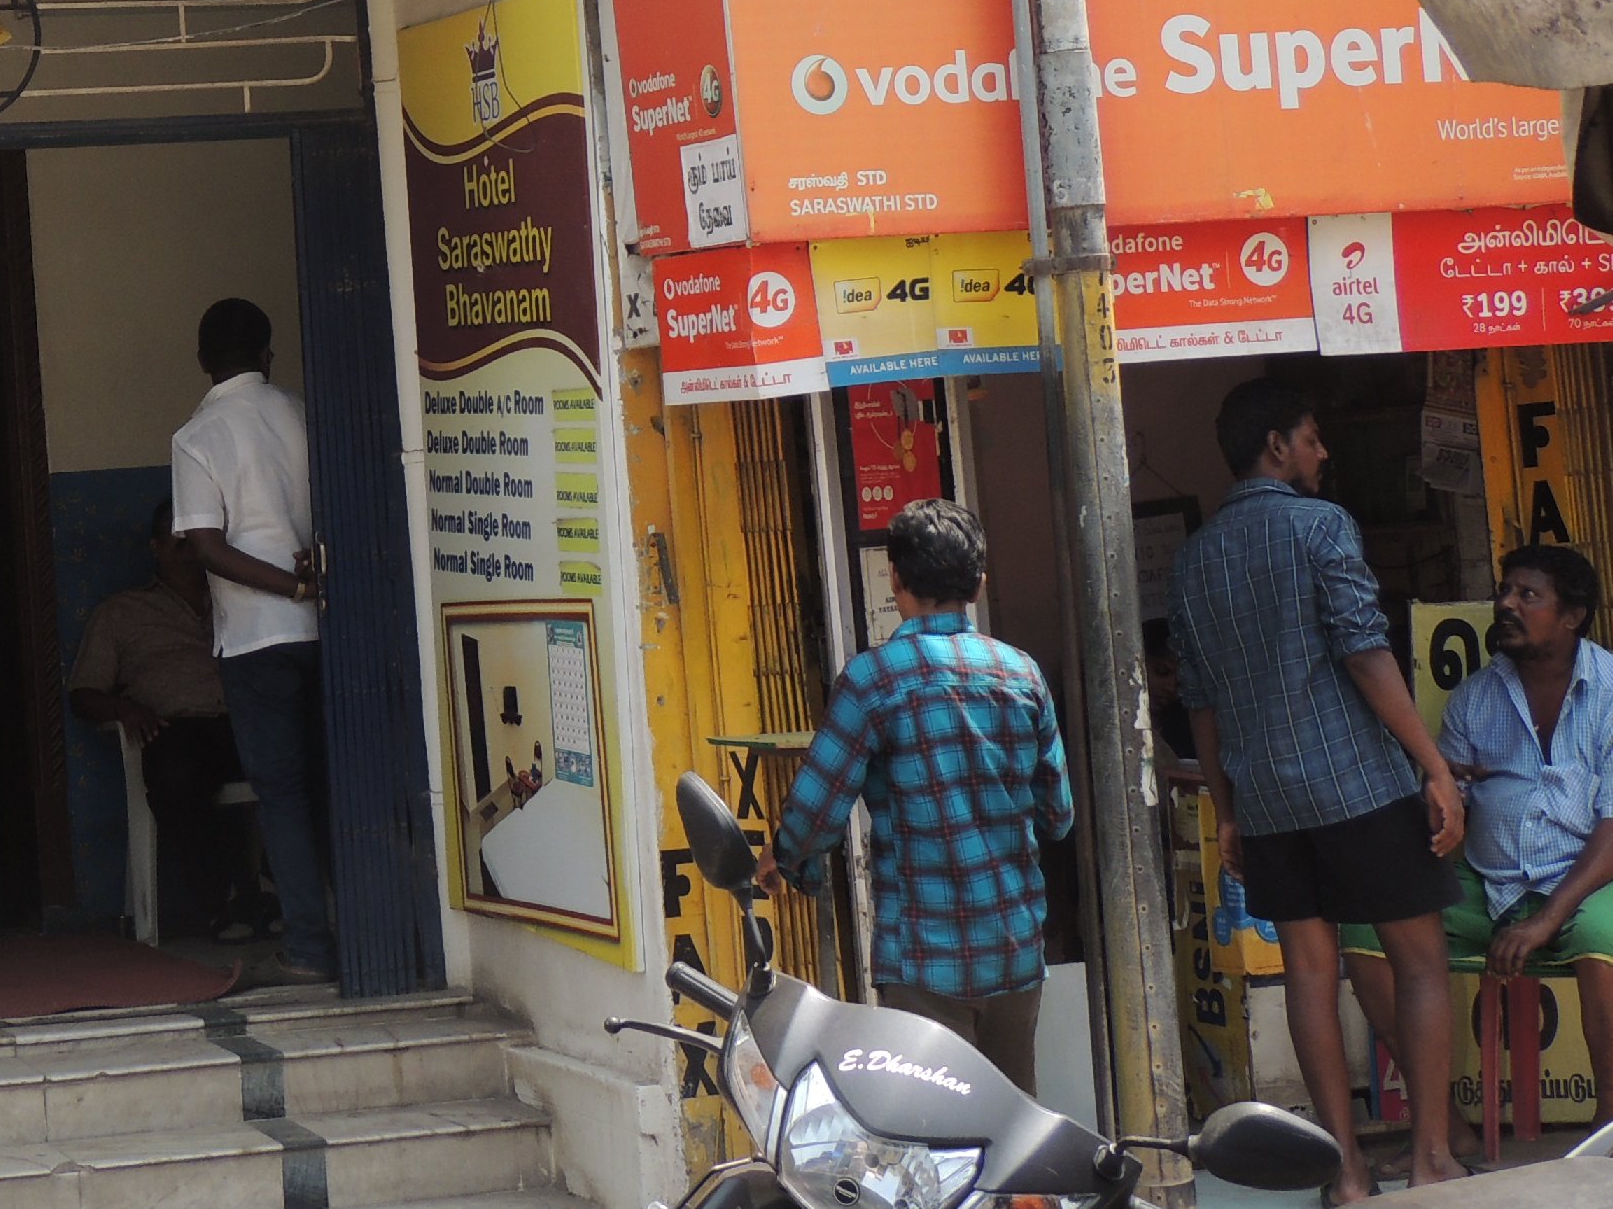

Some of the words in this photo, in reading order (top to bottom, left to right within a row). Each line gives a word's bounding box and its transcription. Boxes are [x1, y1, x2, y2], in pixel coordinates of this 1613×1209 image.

[637, 71, 676, 95] vodafone
[702, 72, 719, 104] 4G
[471, 82, 500, 124] HSB
[1437, 117, 1508, 141] World's
[463, 157, 516, 210] Hotel
[856, 170, 887, 186] STD
[789, 195, 901, 217] SARASWATHI
[904, 194, 938, 211] STD
[437, 215, 553, 274] Saraswathy
[1244, 240, 1283, 273] 4G
[1440, 257, 1512, 278] டேட்டா
[1534, 254, 1575, 274] கால்
[674, 272, 721, 297] vodafone
[886, 277, 930, 302] 4G
[1332, 276, 1380, 296] airtel
[444, 282, 552, 327] Bhavanam
[750, 280, 789, 315] 4G
[1189, 299, 1203, 309] The
[1202, 298, 1220, 308] Data
[1219, 297, 1244, 308] Strong
[1461, 289, 1528, 319] ₹199
[1342, 301, 1374, 325] 4G
[1568, 317, 1583, 329] 70
[1169, 331, 1220, 348] கால்கள்
[1223, 331, 1235, 345] &
[1237, 328, 1283, 344] டேட்டா
[1473, 323, 1487, 333] 28
[850, 360, 907, 375] AVAILABLE
[908, 355, 938, 372] HERE
[962, 350, 1019, 365] AVAILABLE
[424, 391, 456, 415] Deluxe
[459, 390, 494, 415] Double
[496, 393, 512, 418] A/C
[514, 390, 544, 415] Room
[426, 430, 459, 455] Deluxe
[461, 430, 497, 455] Double
[499, 430, 529, 457] Room
[429, 469, 463, 494] Normal
[465, 470, 500, 496] Double
[503, 472, 533, 498] Room
[431, 508, 465, 534] Normal
[467, 510, 499, 541] Single
[501, 513, 532, 540] Room
[433, 547, 468, 573] Normal
[470, 550, 502, 582] Single
[503, 554, 534, 581] Room
[838, 1048, 971, 1096] E.Dharshan
